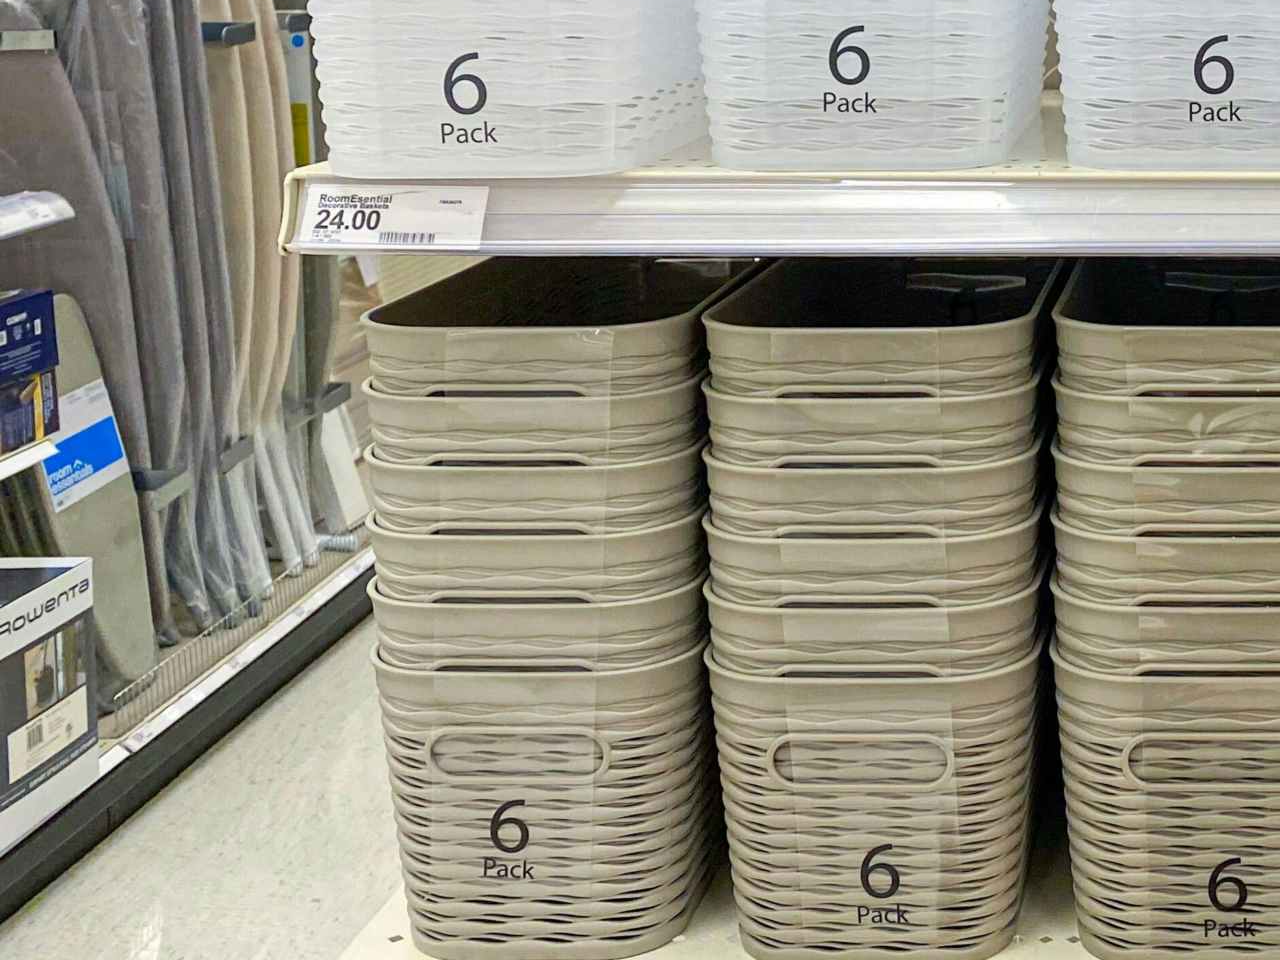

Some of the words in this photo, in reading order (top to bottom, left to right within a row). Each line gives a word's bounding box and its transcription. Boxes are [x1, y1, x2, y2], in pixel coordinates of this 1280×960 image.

[828, 25, 871, 86] 6
[1193, 34, 1236, 95] 6
[443, 52, 489, 115] 6
[822, 91, 878, 114] Pack
[1188, 100, 1245, 123] Pack
[440, 120, 499, 145] Pack
[314, 209, 381, 231] 24.00
[489, 799, 530, 854] 6
[482, 856, 535, 880] Pack
[860, 843, 900, 899] 6
[1207, 856, 1248, 913] 6
[856, 903, 910, 925] Pack
[1203, 917, 1257, 938] Pack
